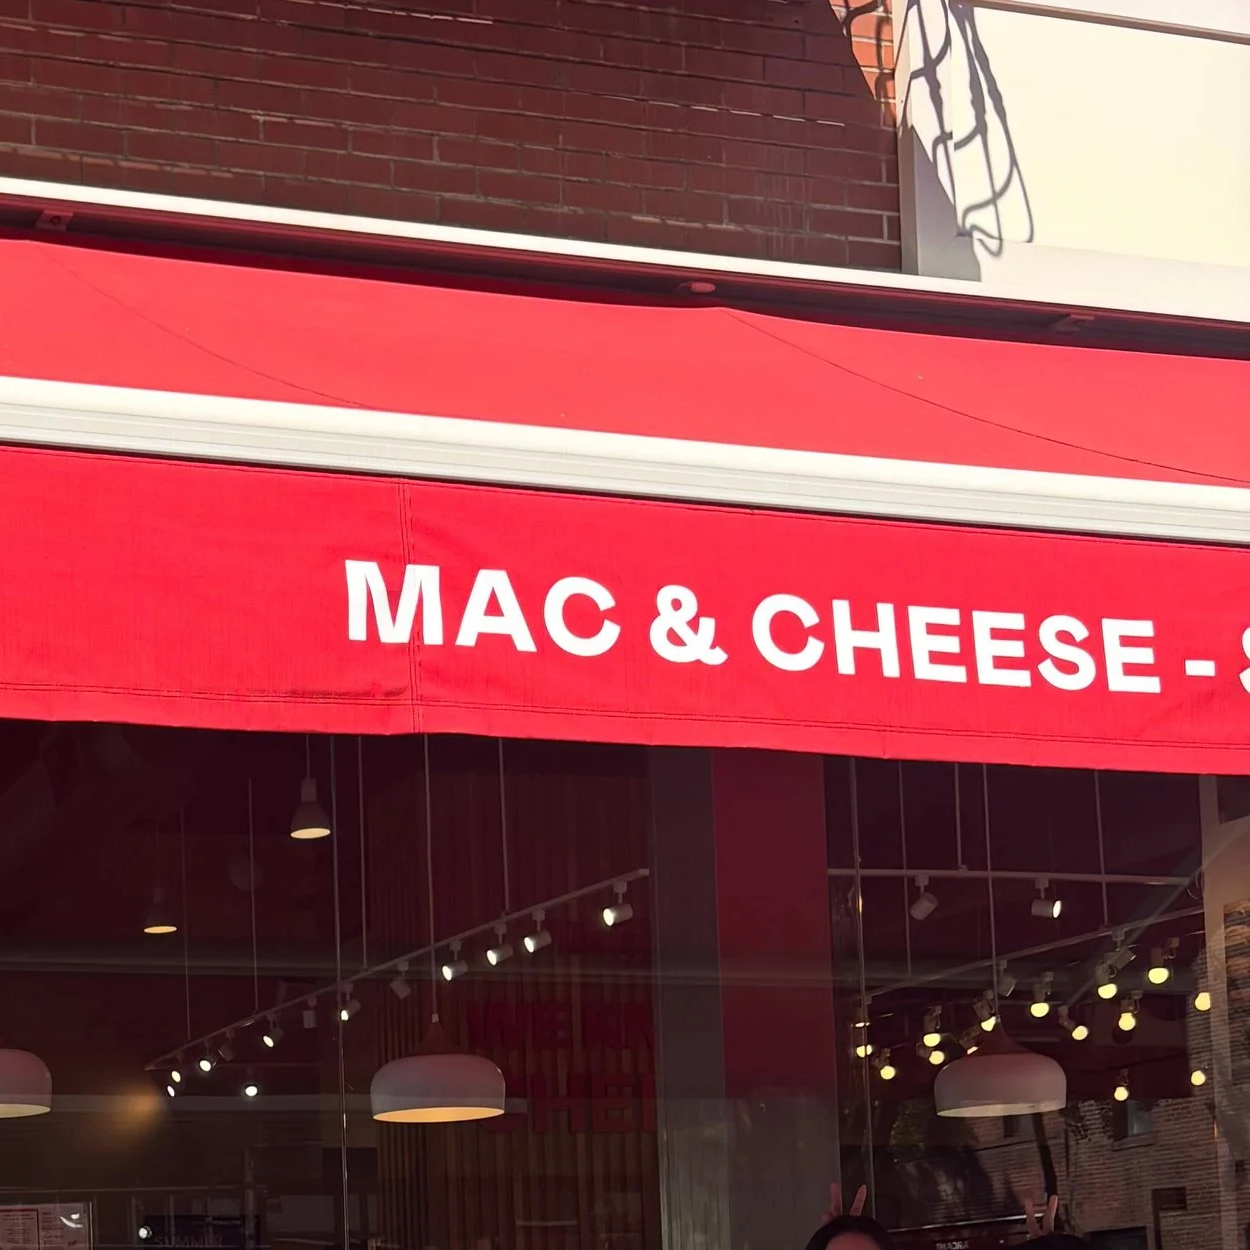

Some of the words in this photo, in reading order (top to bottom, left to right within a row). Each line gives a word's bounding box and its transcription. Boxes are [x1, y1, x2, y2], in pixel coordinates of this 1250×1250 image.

[345, 560, 620, 657] MAC
[649, 585, 727, 664] &
[752, 593, 1161, 694] CHEESE
